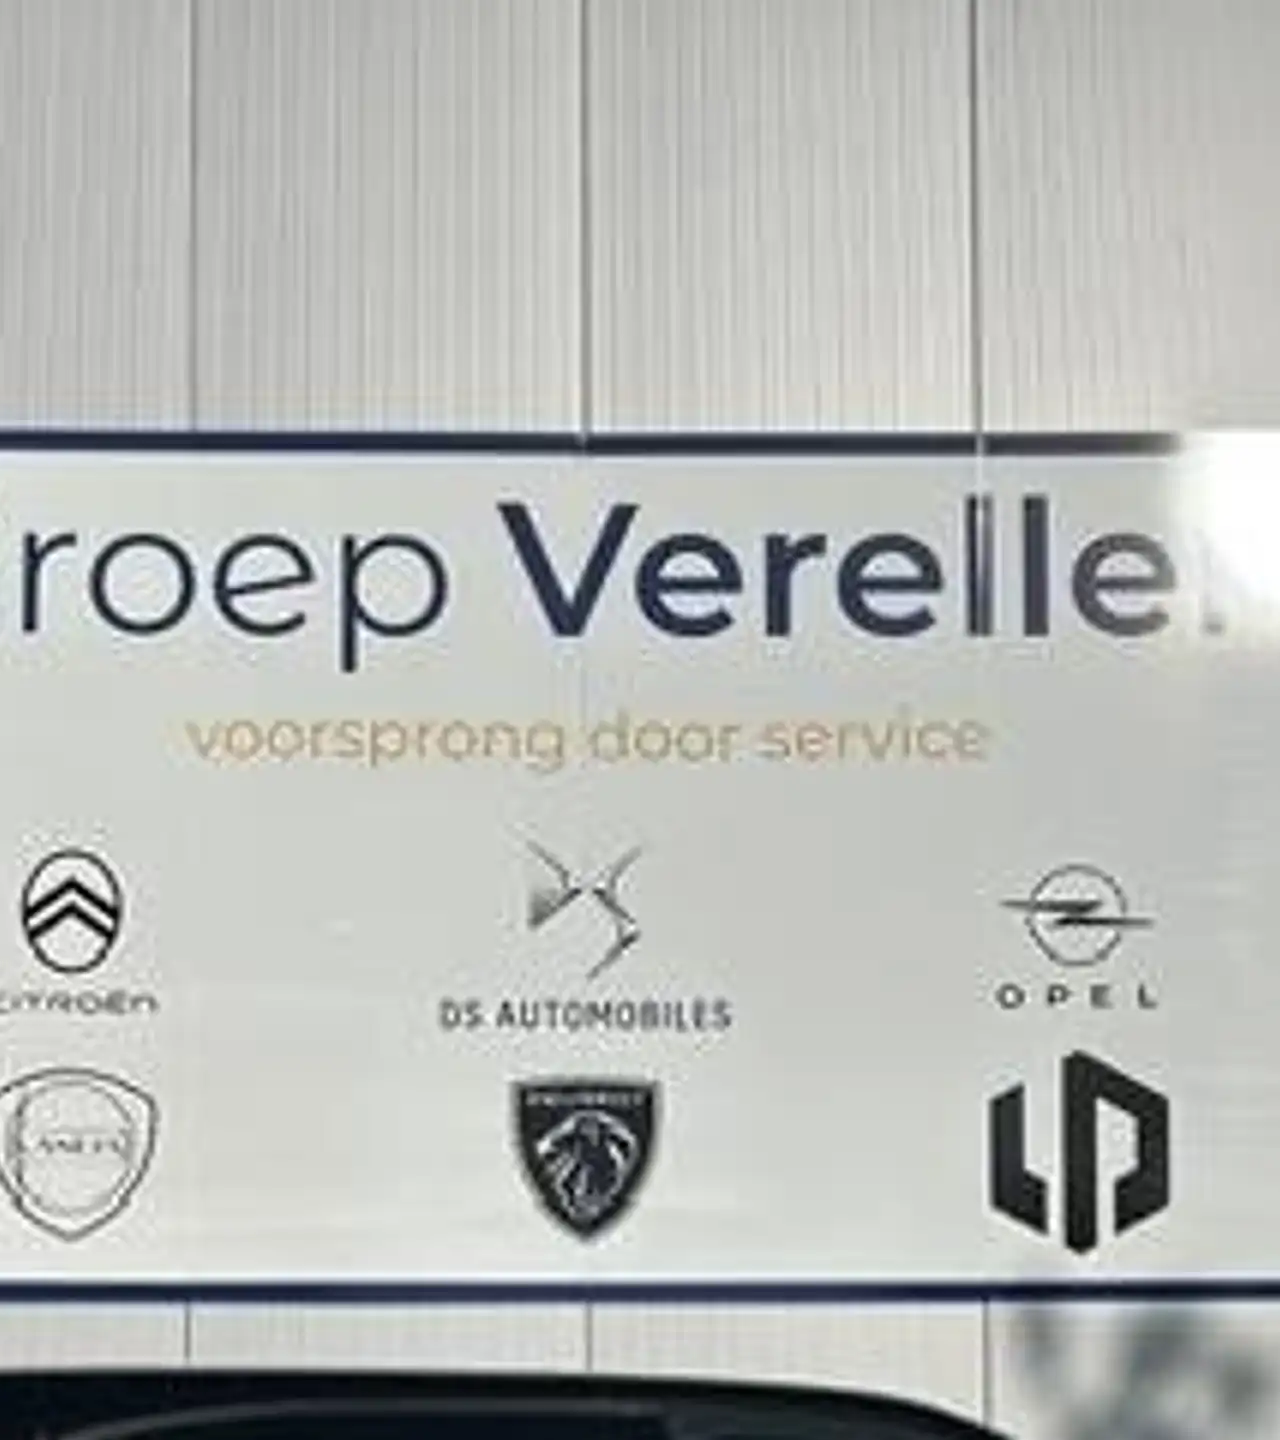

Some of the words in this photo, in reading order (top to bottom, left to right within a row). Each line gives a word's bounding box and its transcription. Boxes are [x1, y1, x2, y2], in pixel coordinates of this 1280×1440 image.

[185, 719, 565, 772] voorsprong
[590, 704, 741, 763] door
[755, 702, 991, 762] service
[996, 982, 1159, 1011] OPEL
[437, 999, 483, 1031] DS
[495, 999, 732, 1033] AUTOMOBILES
